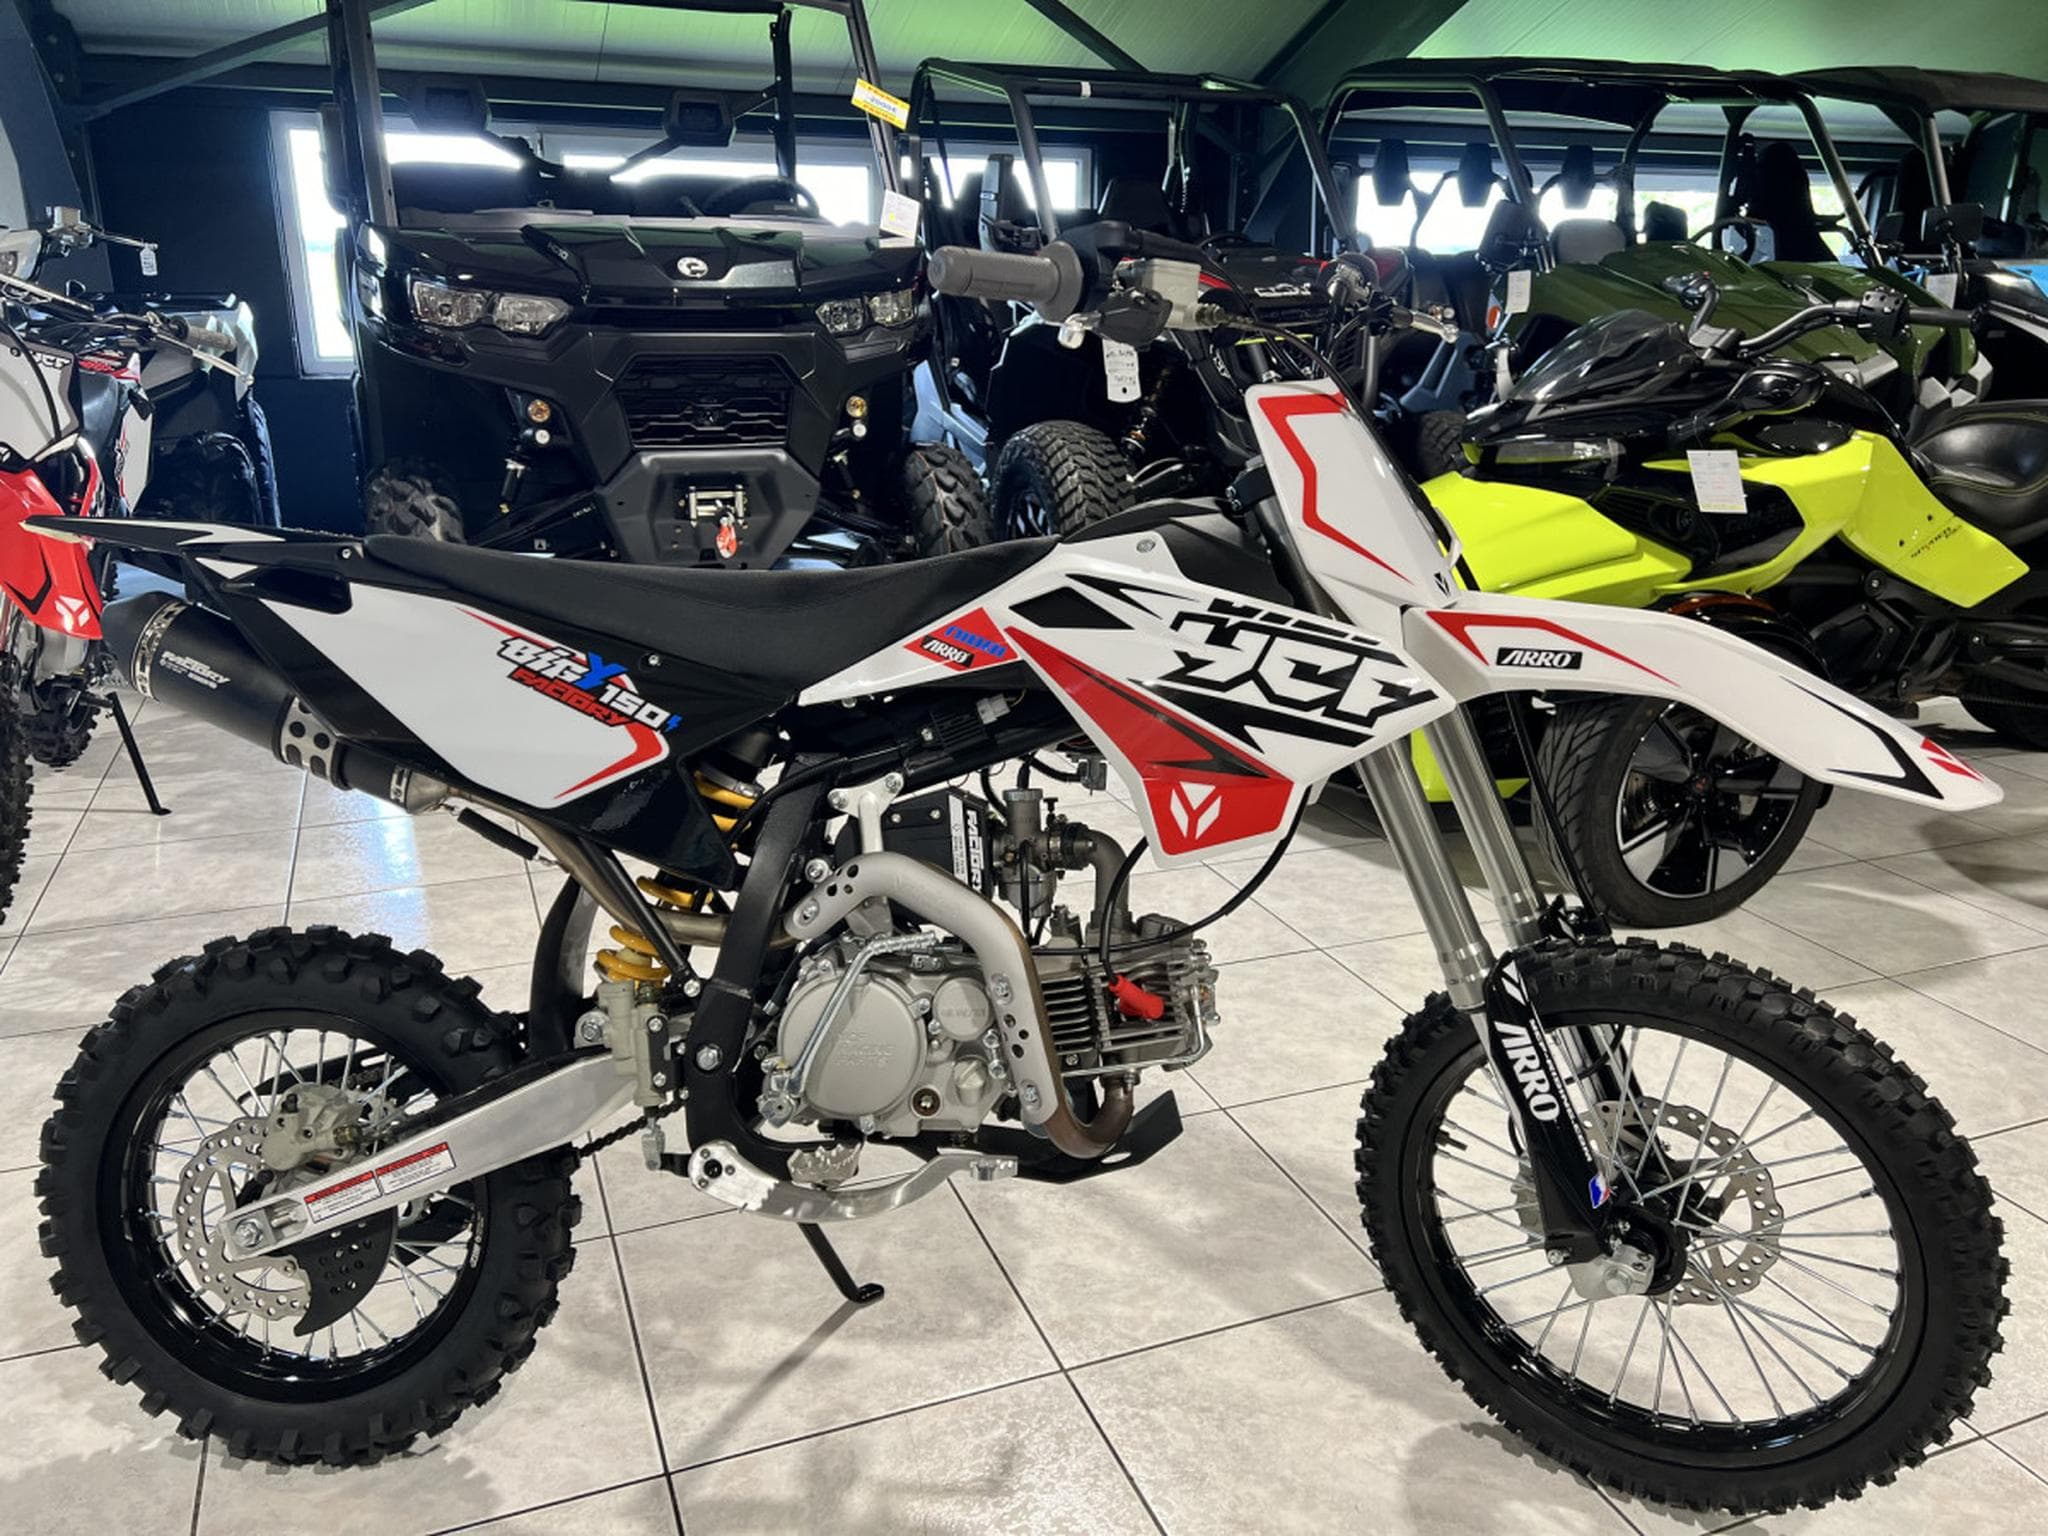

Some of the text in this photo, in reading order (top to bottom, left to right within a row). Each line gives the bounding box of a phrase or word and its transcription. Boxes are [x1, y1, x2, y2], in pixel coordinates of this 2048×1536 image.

[922, 639, 970, 663] ARRO
[1157, 610, 1439, 728] YCF
[1500, 649, 1573, 668] ARRO
[507, 666, 633, 727] FACTORY
[599, 682, 671, 731] 150
[1493, 1020, 1561, 1121] ARRO
